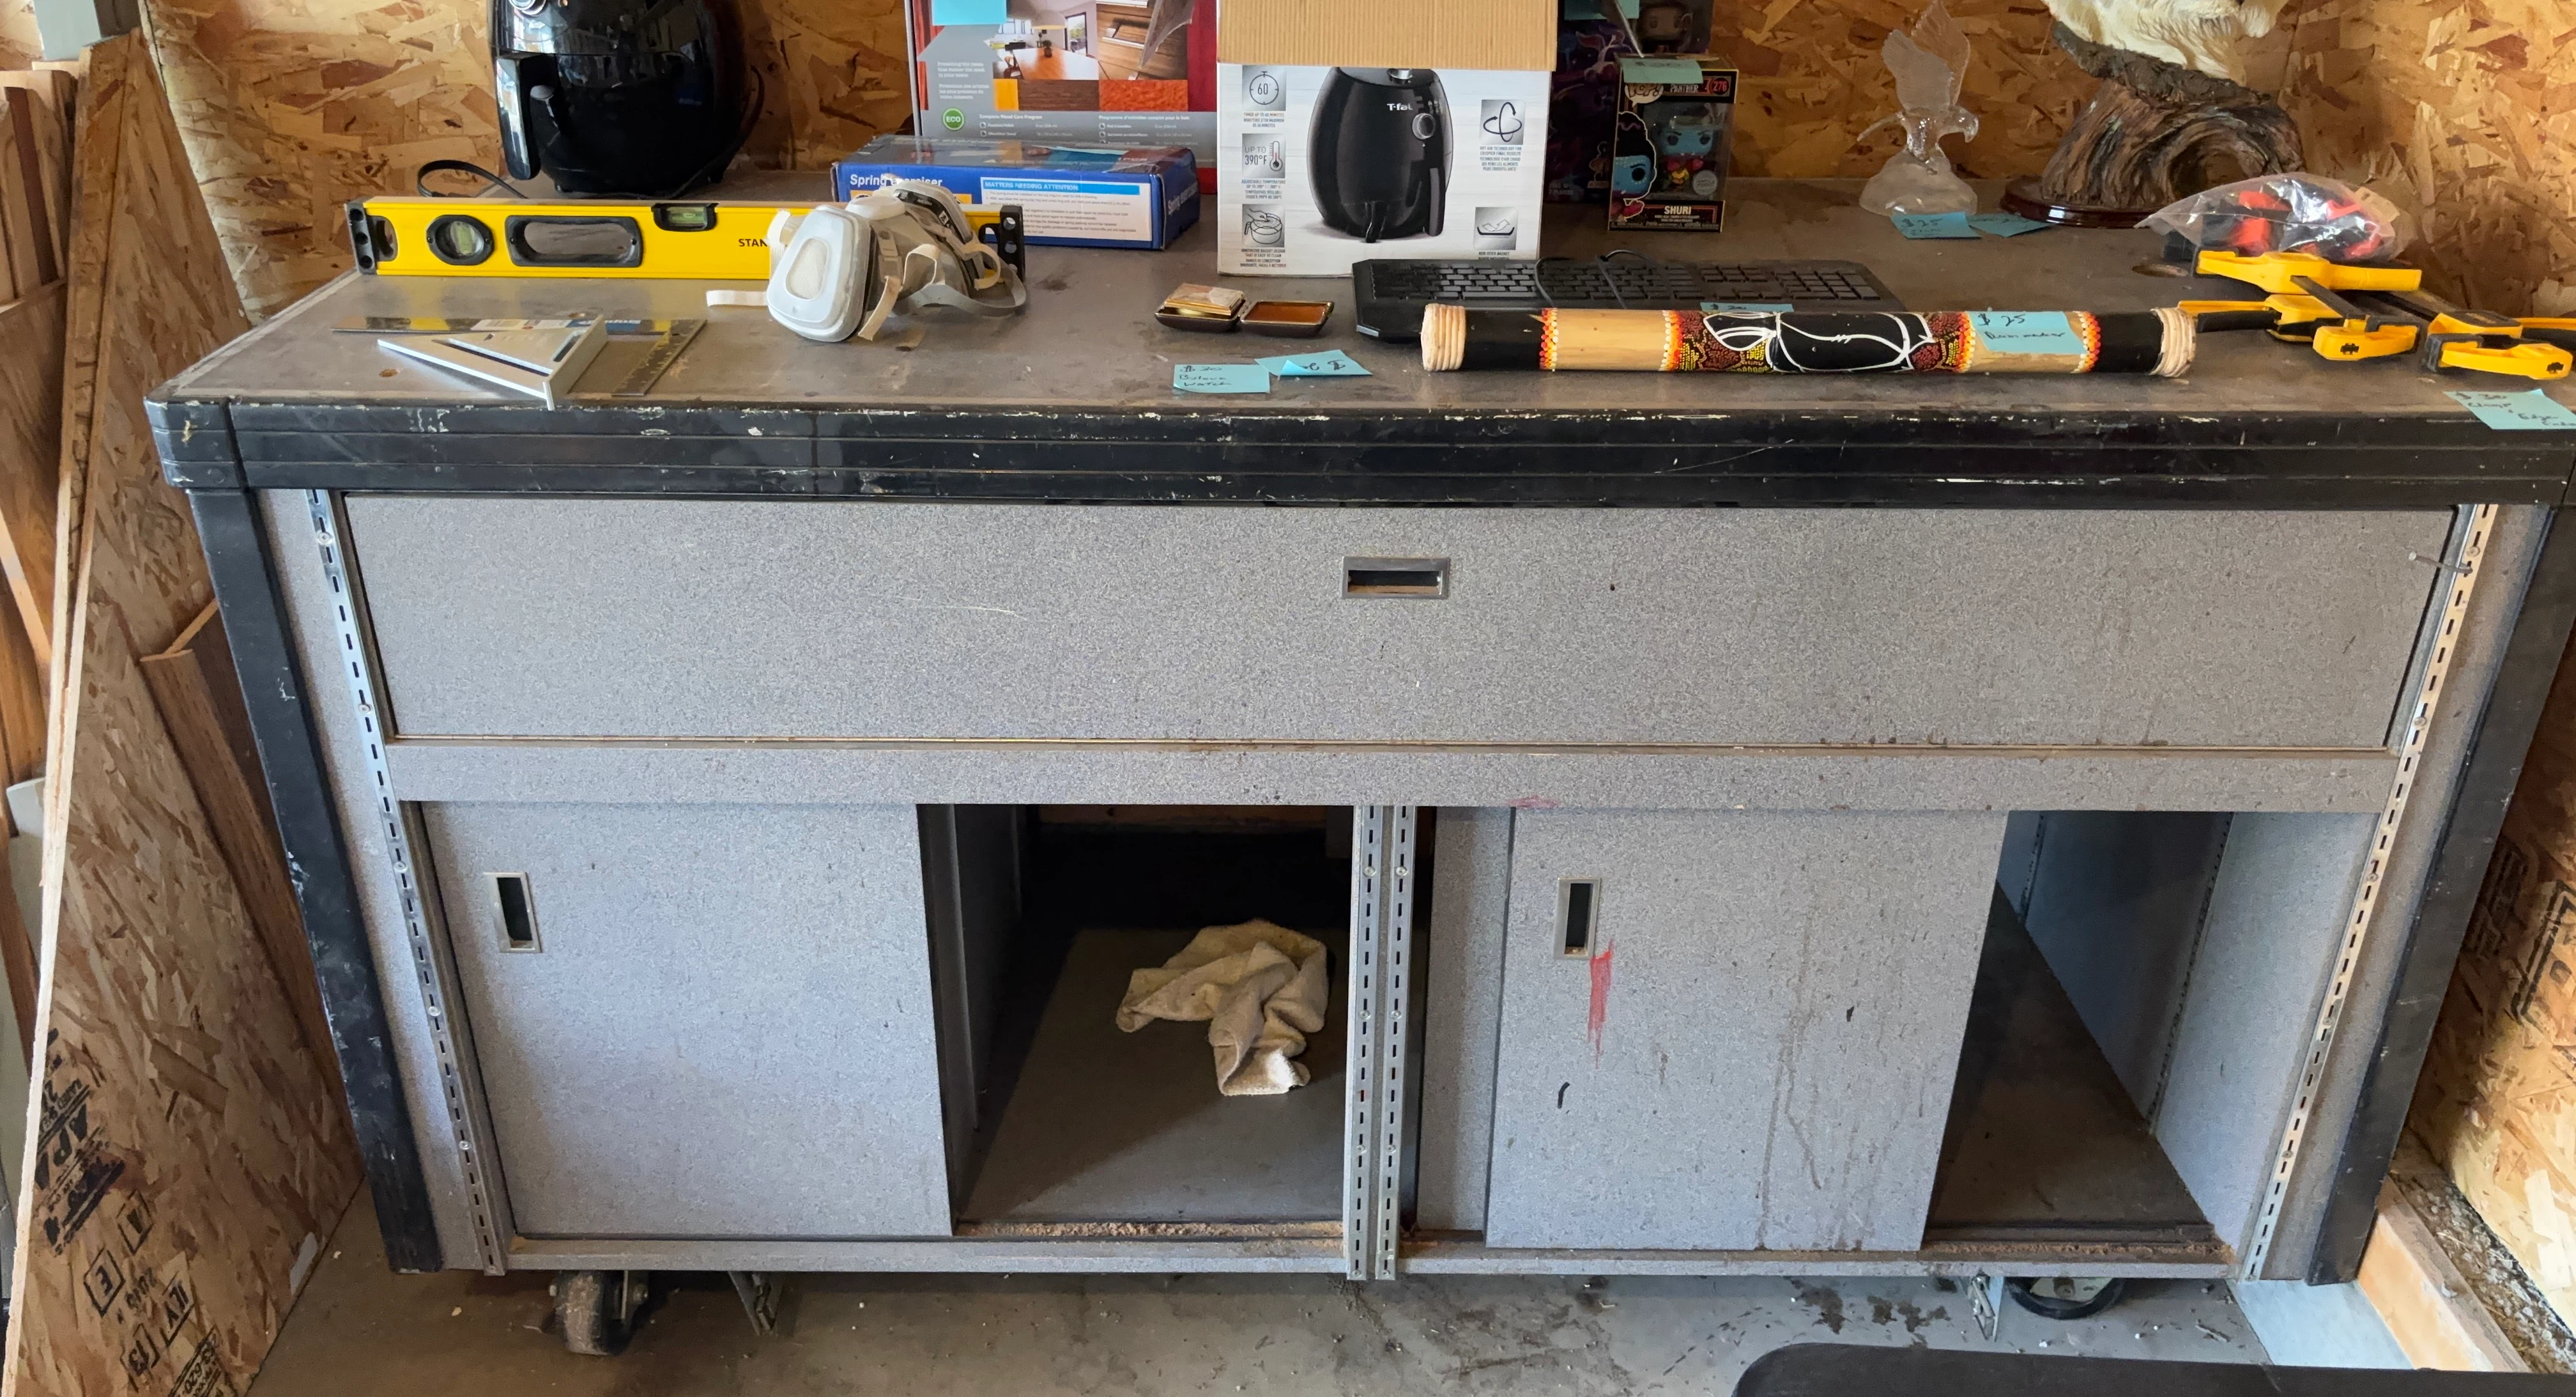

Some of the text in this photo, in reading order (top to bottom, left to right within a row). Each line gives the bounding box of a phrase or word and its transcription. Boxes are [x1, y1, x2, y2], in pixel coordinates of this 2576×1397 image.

[1713, 82, 1728, 92] 276
[1245, 155, 1267, 166] 390°F
[850, 174, 887, 188] Spring
[1664, 206, 1692, 215] SHURI
[1977, 313, 2025, 327] $ 25
[95, 1265, 113, 1296] E
